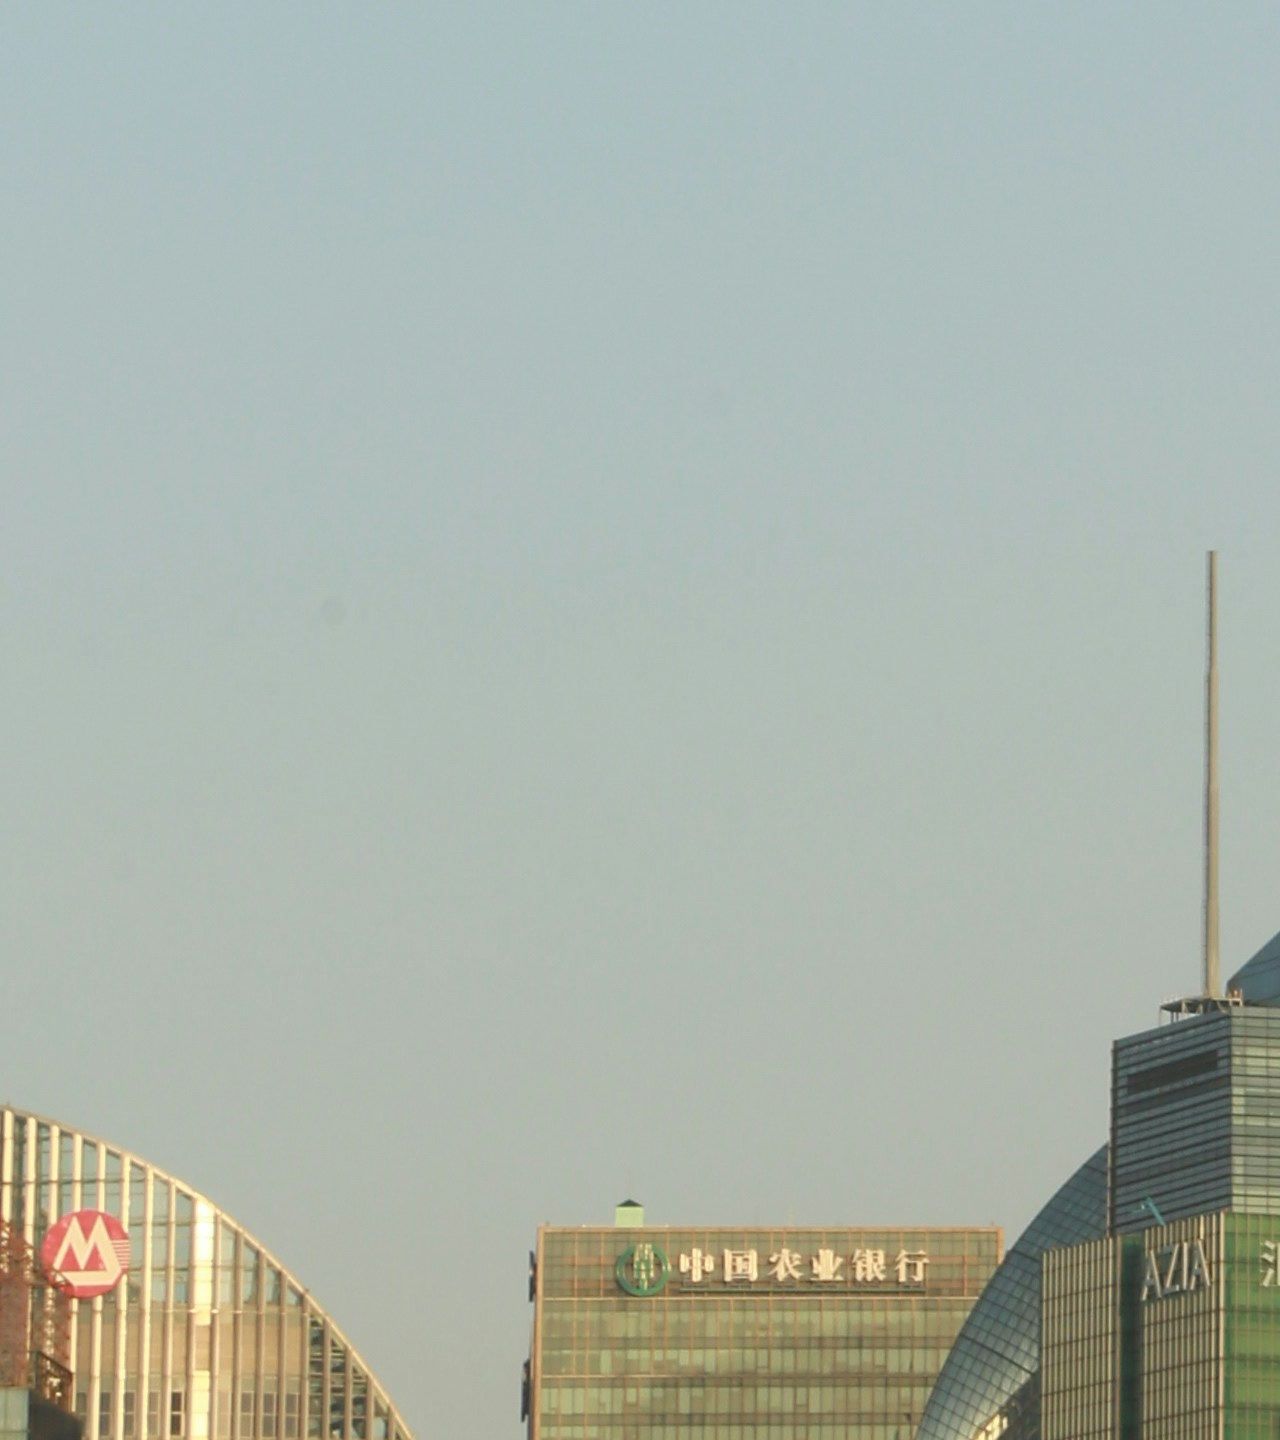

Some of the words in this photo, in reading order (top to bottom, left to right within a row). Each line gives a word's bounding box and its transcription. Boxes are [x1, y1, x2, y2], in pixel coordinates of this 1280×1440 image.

[679, 1247, 931, 1283] 中国农业银行
[1141, 1235, 1211, 1302] AZIA
